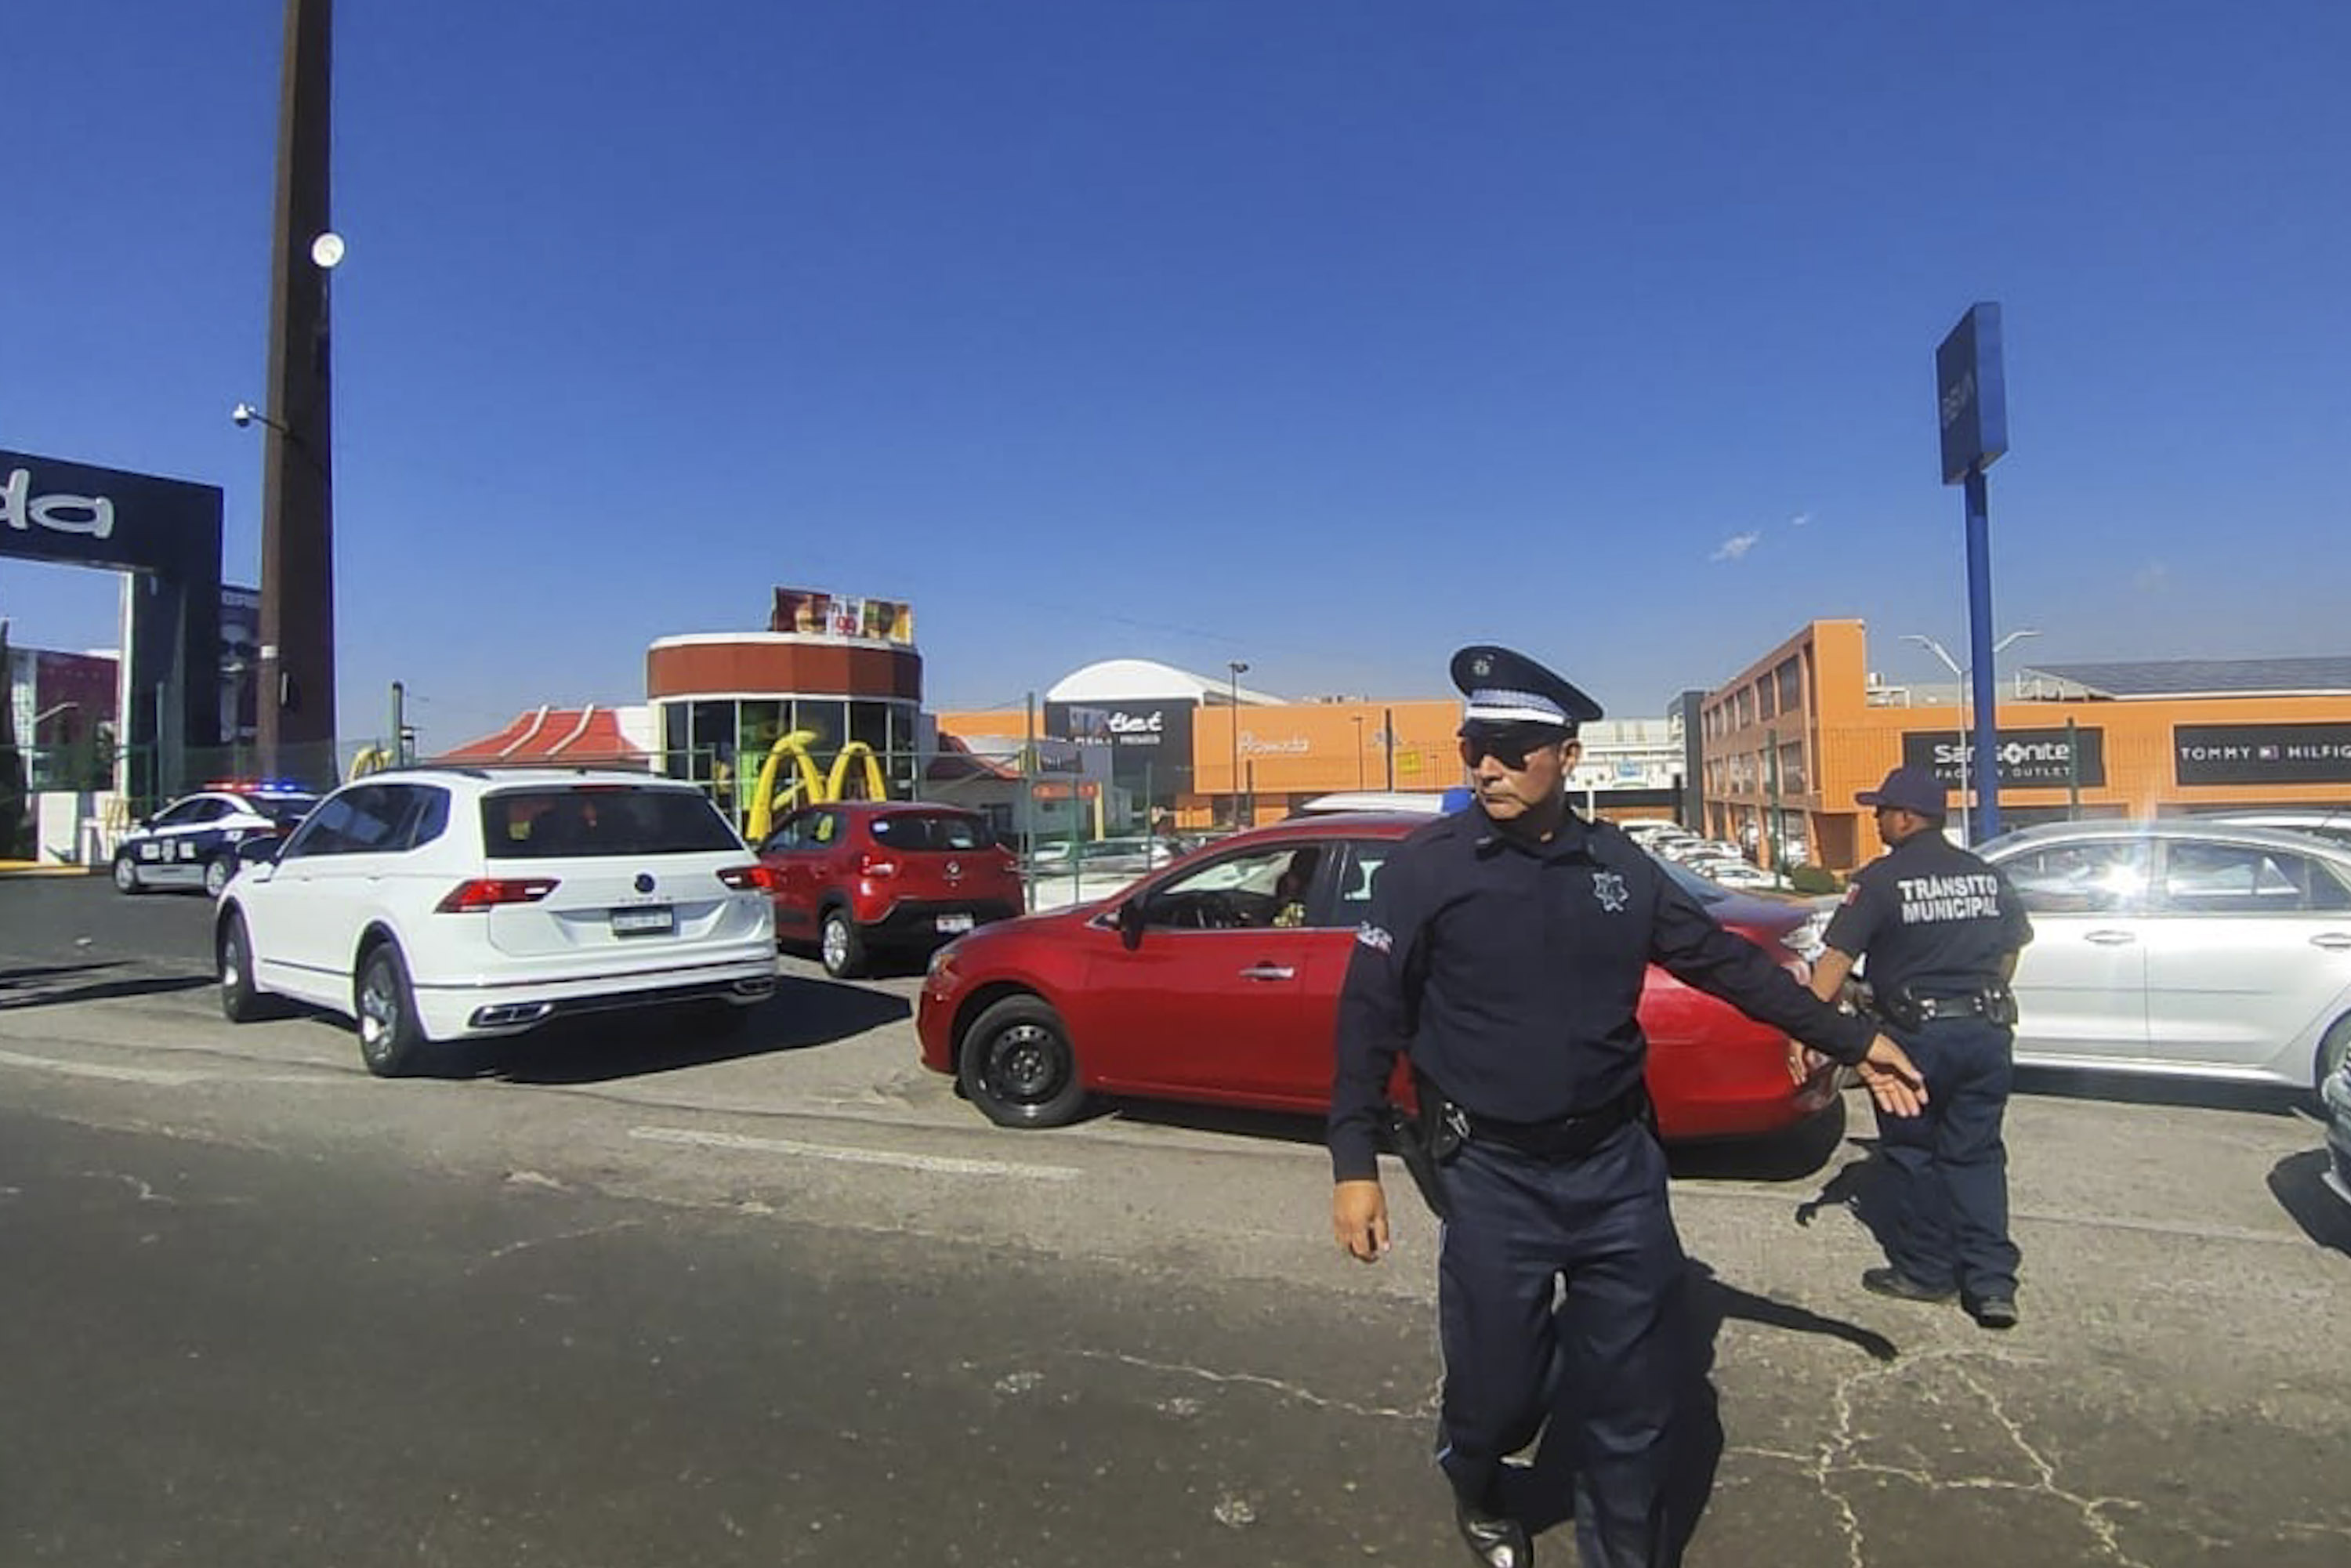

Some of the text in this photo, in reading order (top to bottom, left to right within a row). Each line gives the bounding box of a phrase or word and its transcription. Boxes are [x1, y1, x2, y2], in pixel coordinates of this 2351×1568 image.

[0, 469, 114, 539] da
[2181, 744, 2351, 761] TOMMY HILFIG
[2012, 766, 2071, 777] OUTLET
[1901, 896, 2001, 924] MUNICIPAL
